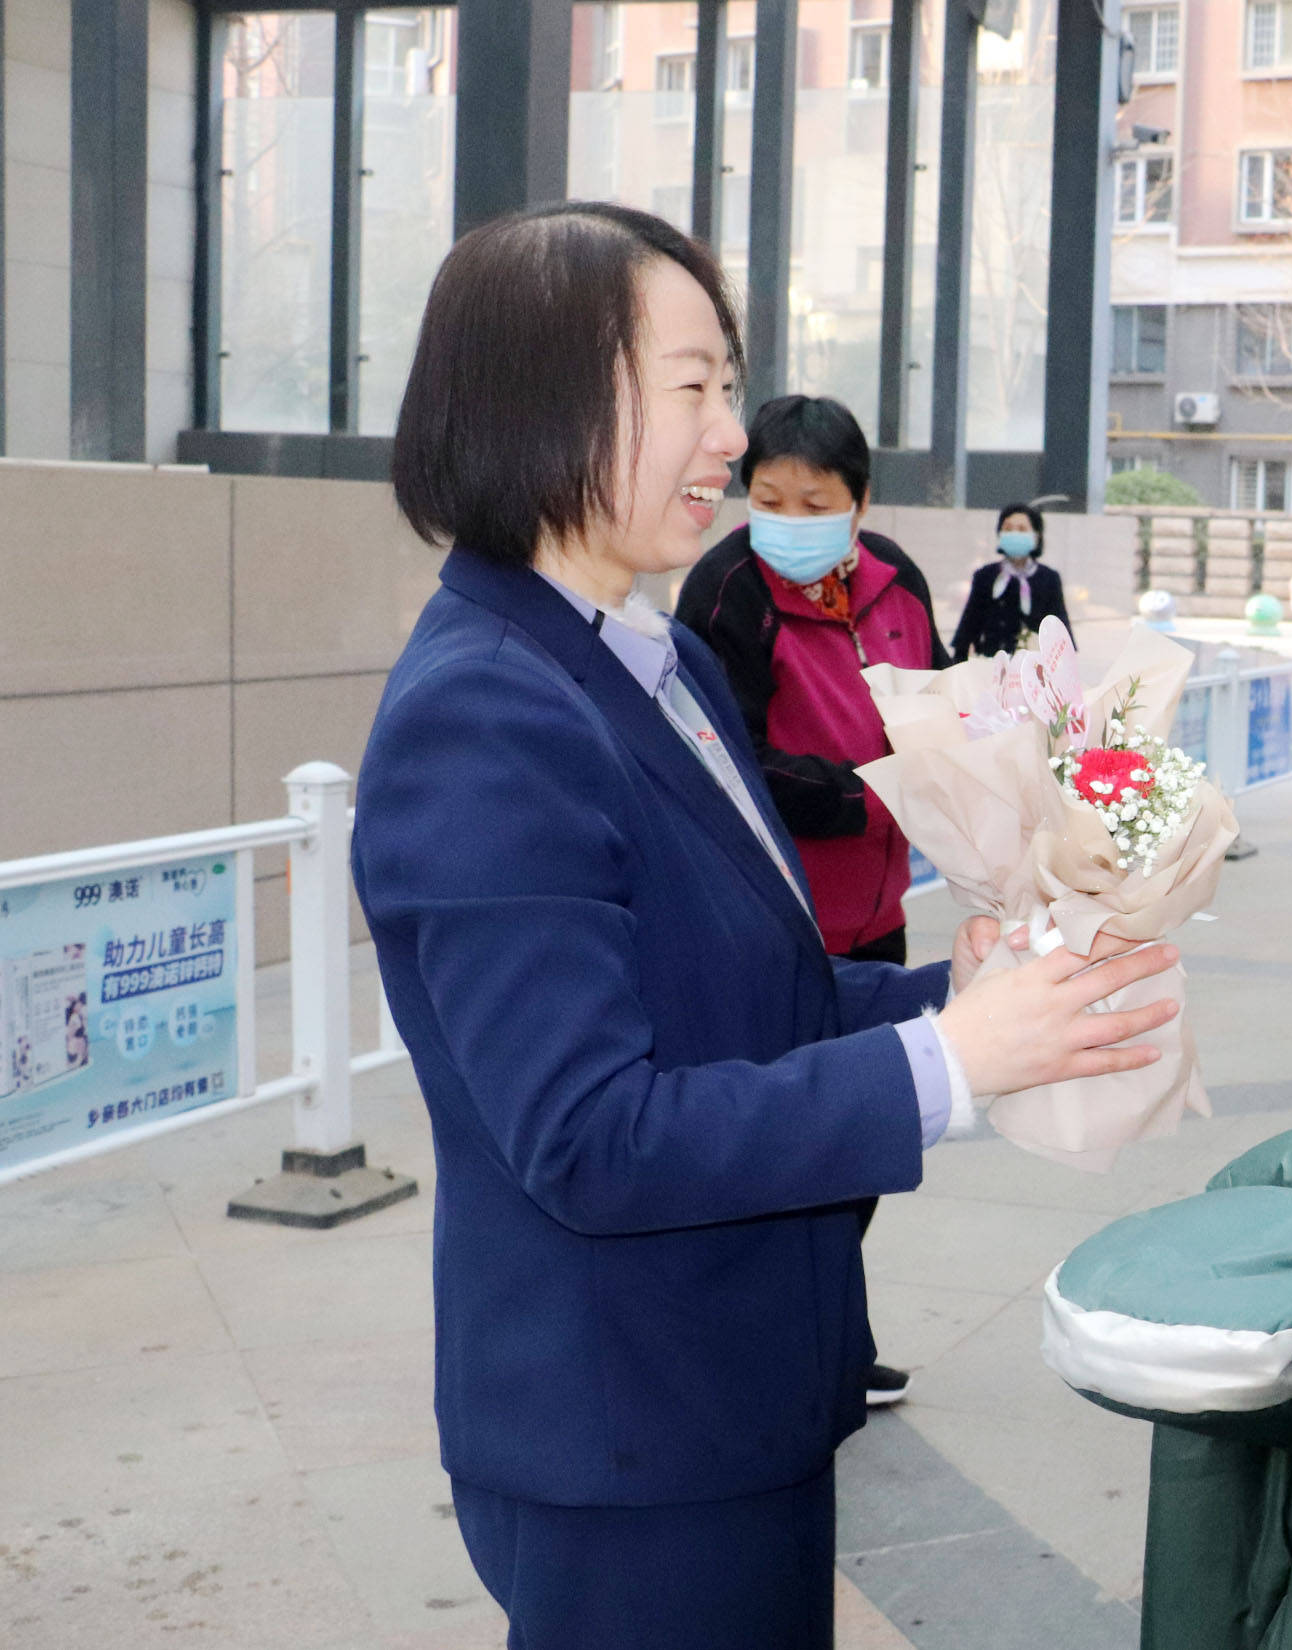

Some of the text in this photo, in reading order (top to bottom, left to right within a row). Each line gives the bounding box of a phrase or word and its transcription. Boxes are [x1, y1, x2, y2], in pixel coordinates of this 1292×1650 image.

[74, 883, 101, 909] 999
[103, 918, 226, 968] 助力儿童长高
